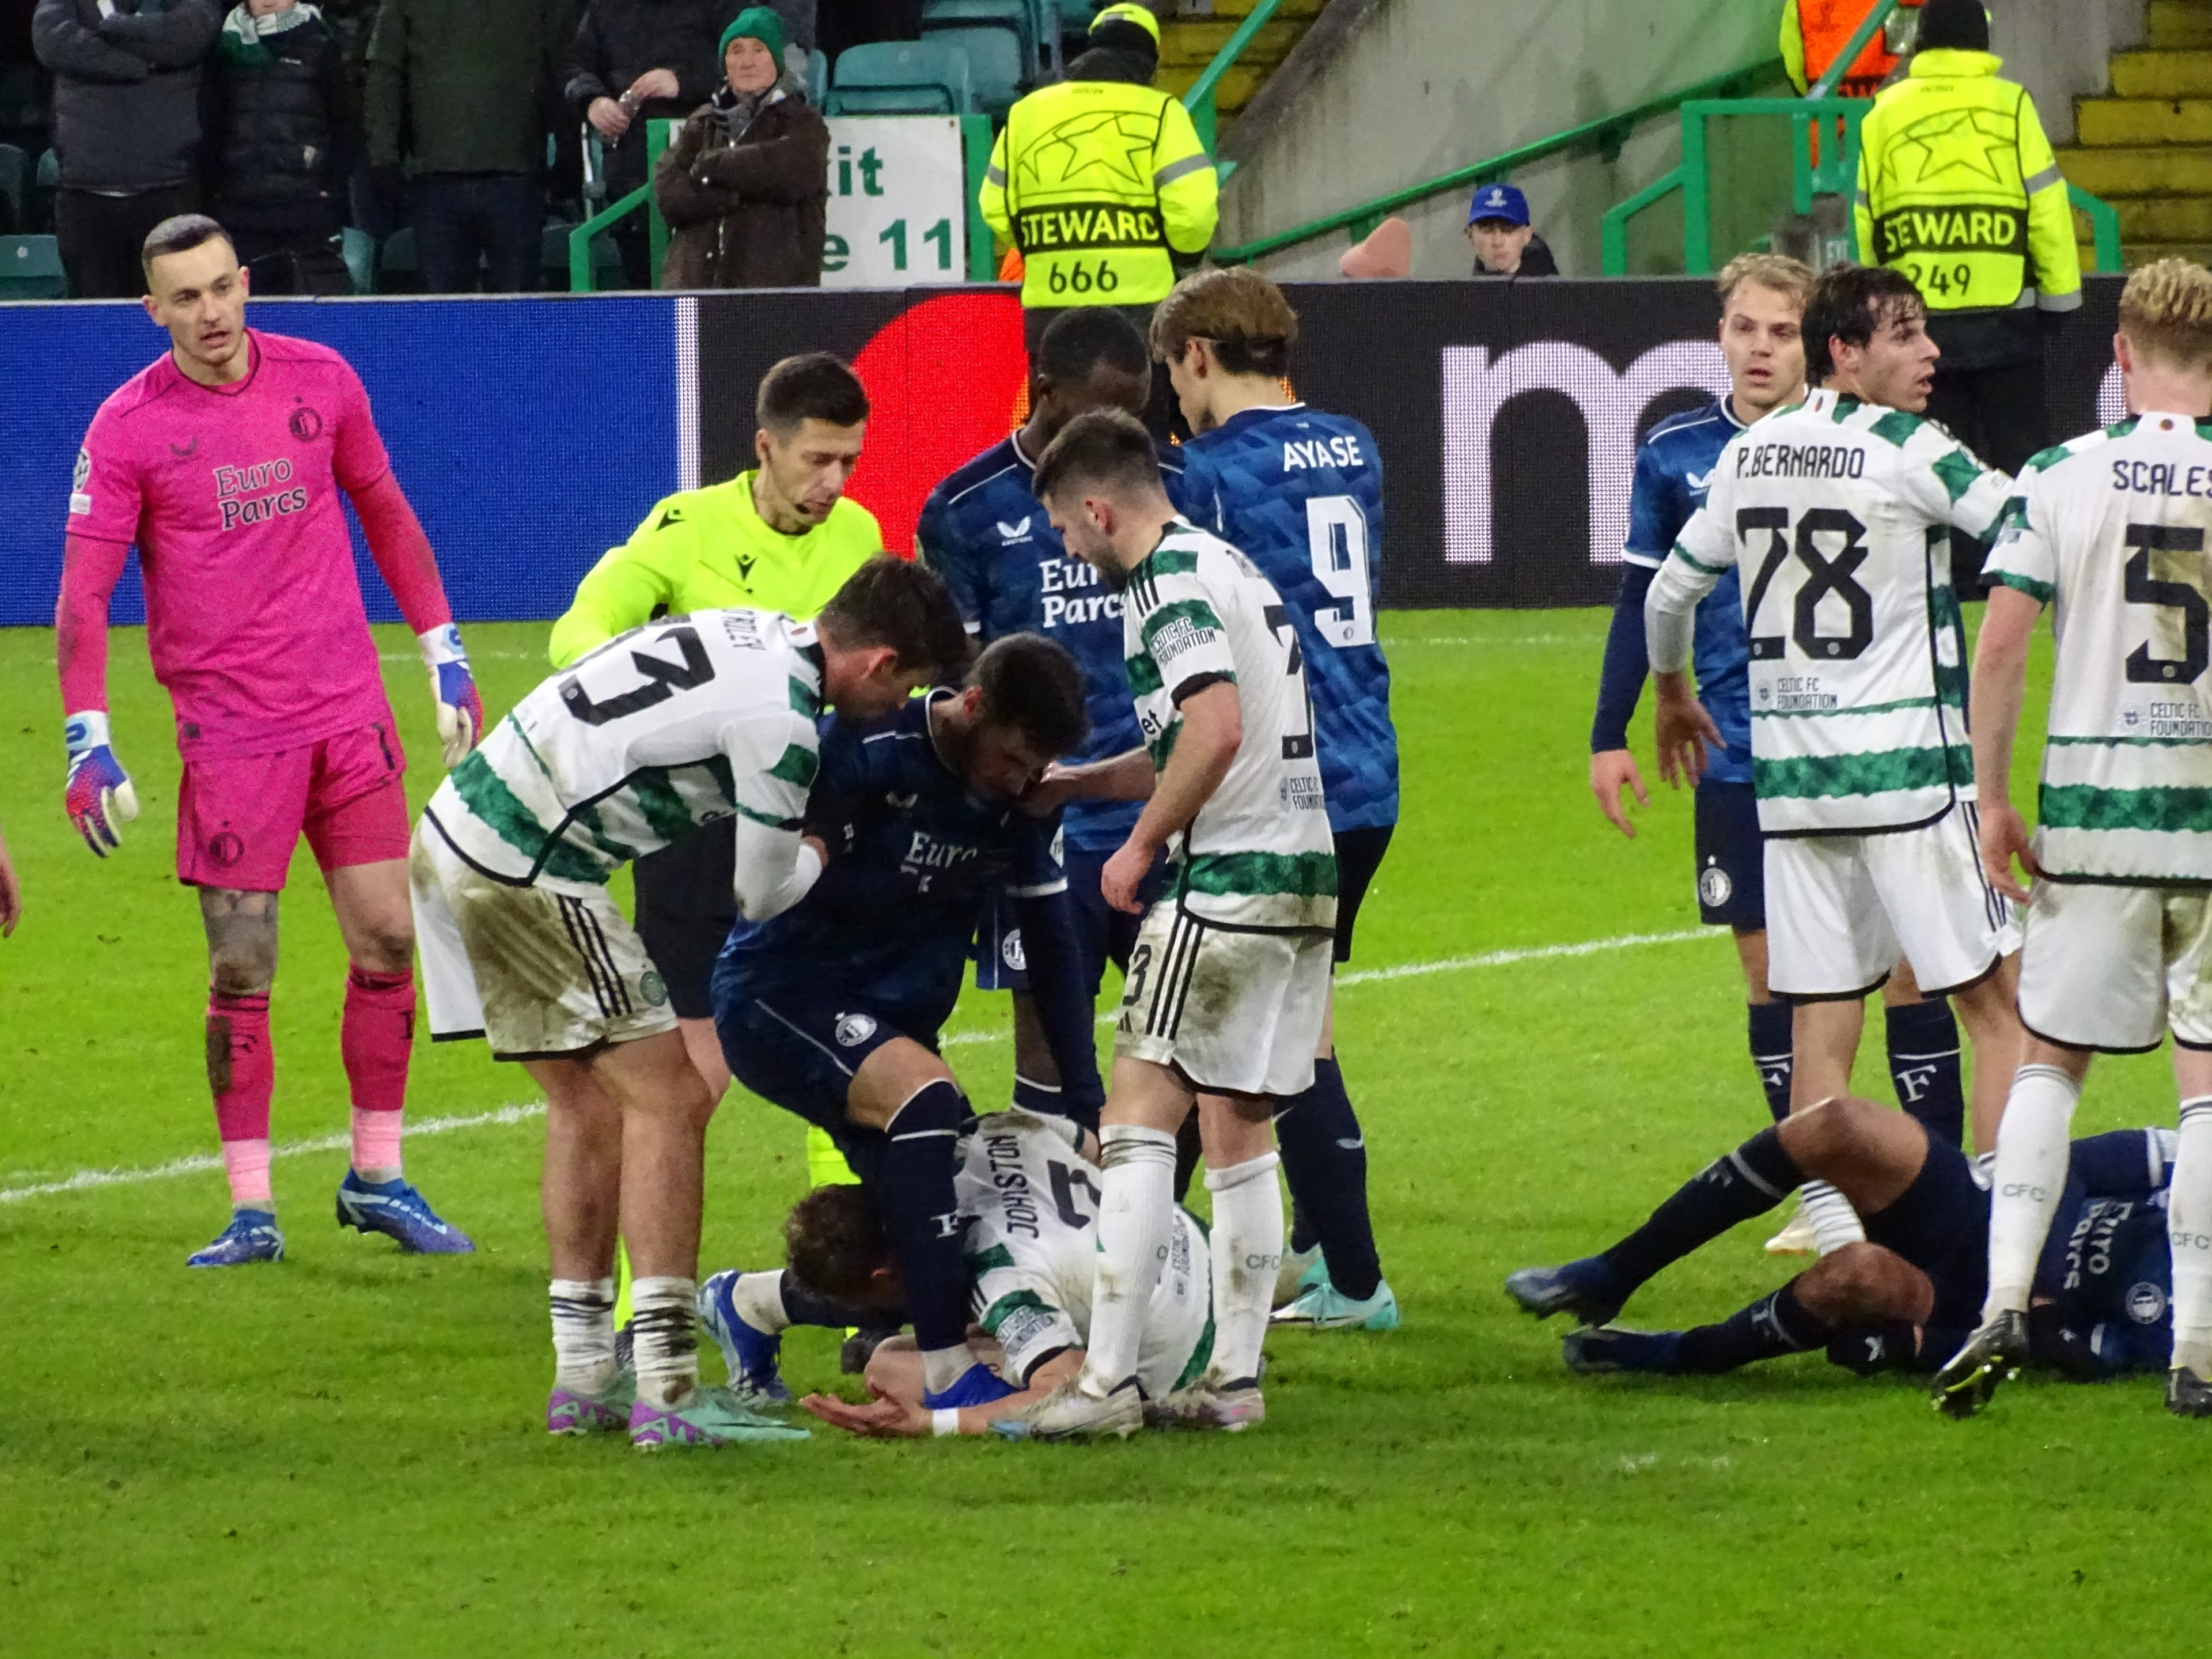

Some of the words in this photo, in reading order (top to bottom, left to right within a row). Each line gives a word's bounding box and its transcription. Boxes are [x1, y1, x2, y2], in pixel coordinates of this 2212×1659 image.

[827, 146, 884, 196] it
[879, 218, 951, 271] 11
[1049, 260, 1119, 294] 666
[1283, 435, 1364, 472] AYASE
[1736, 444, 1865, 479] P.BERNARDO
[212, 459, 293, 498] Euro
[220, 487, 307, 531] Parcs
[1039, 559, 1099, 593] Eur
[1306, 495, 1376, 648] 9
[1736, 507, 1873, 660] 78
[2124, 523, 2210, 684] 5
[1806, 677, 1820, 691] FC
[2150, 719, 2212, 737] FOUNDATIO
[1122, 944, 1152, 1007] 3
[1895, 1064, 1937, 1103] F
[2002, 1183, 2048, 1202] CFC
[2172, 1232, 2211, 1250] CFC
